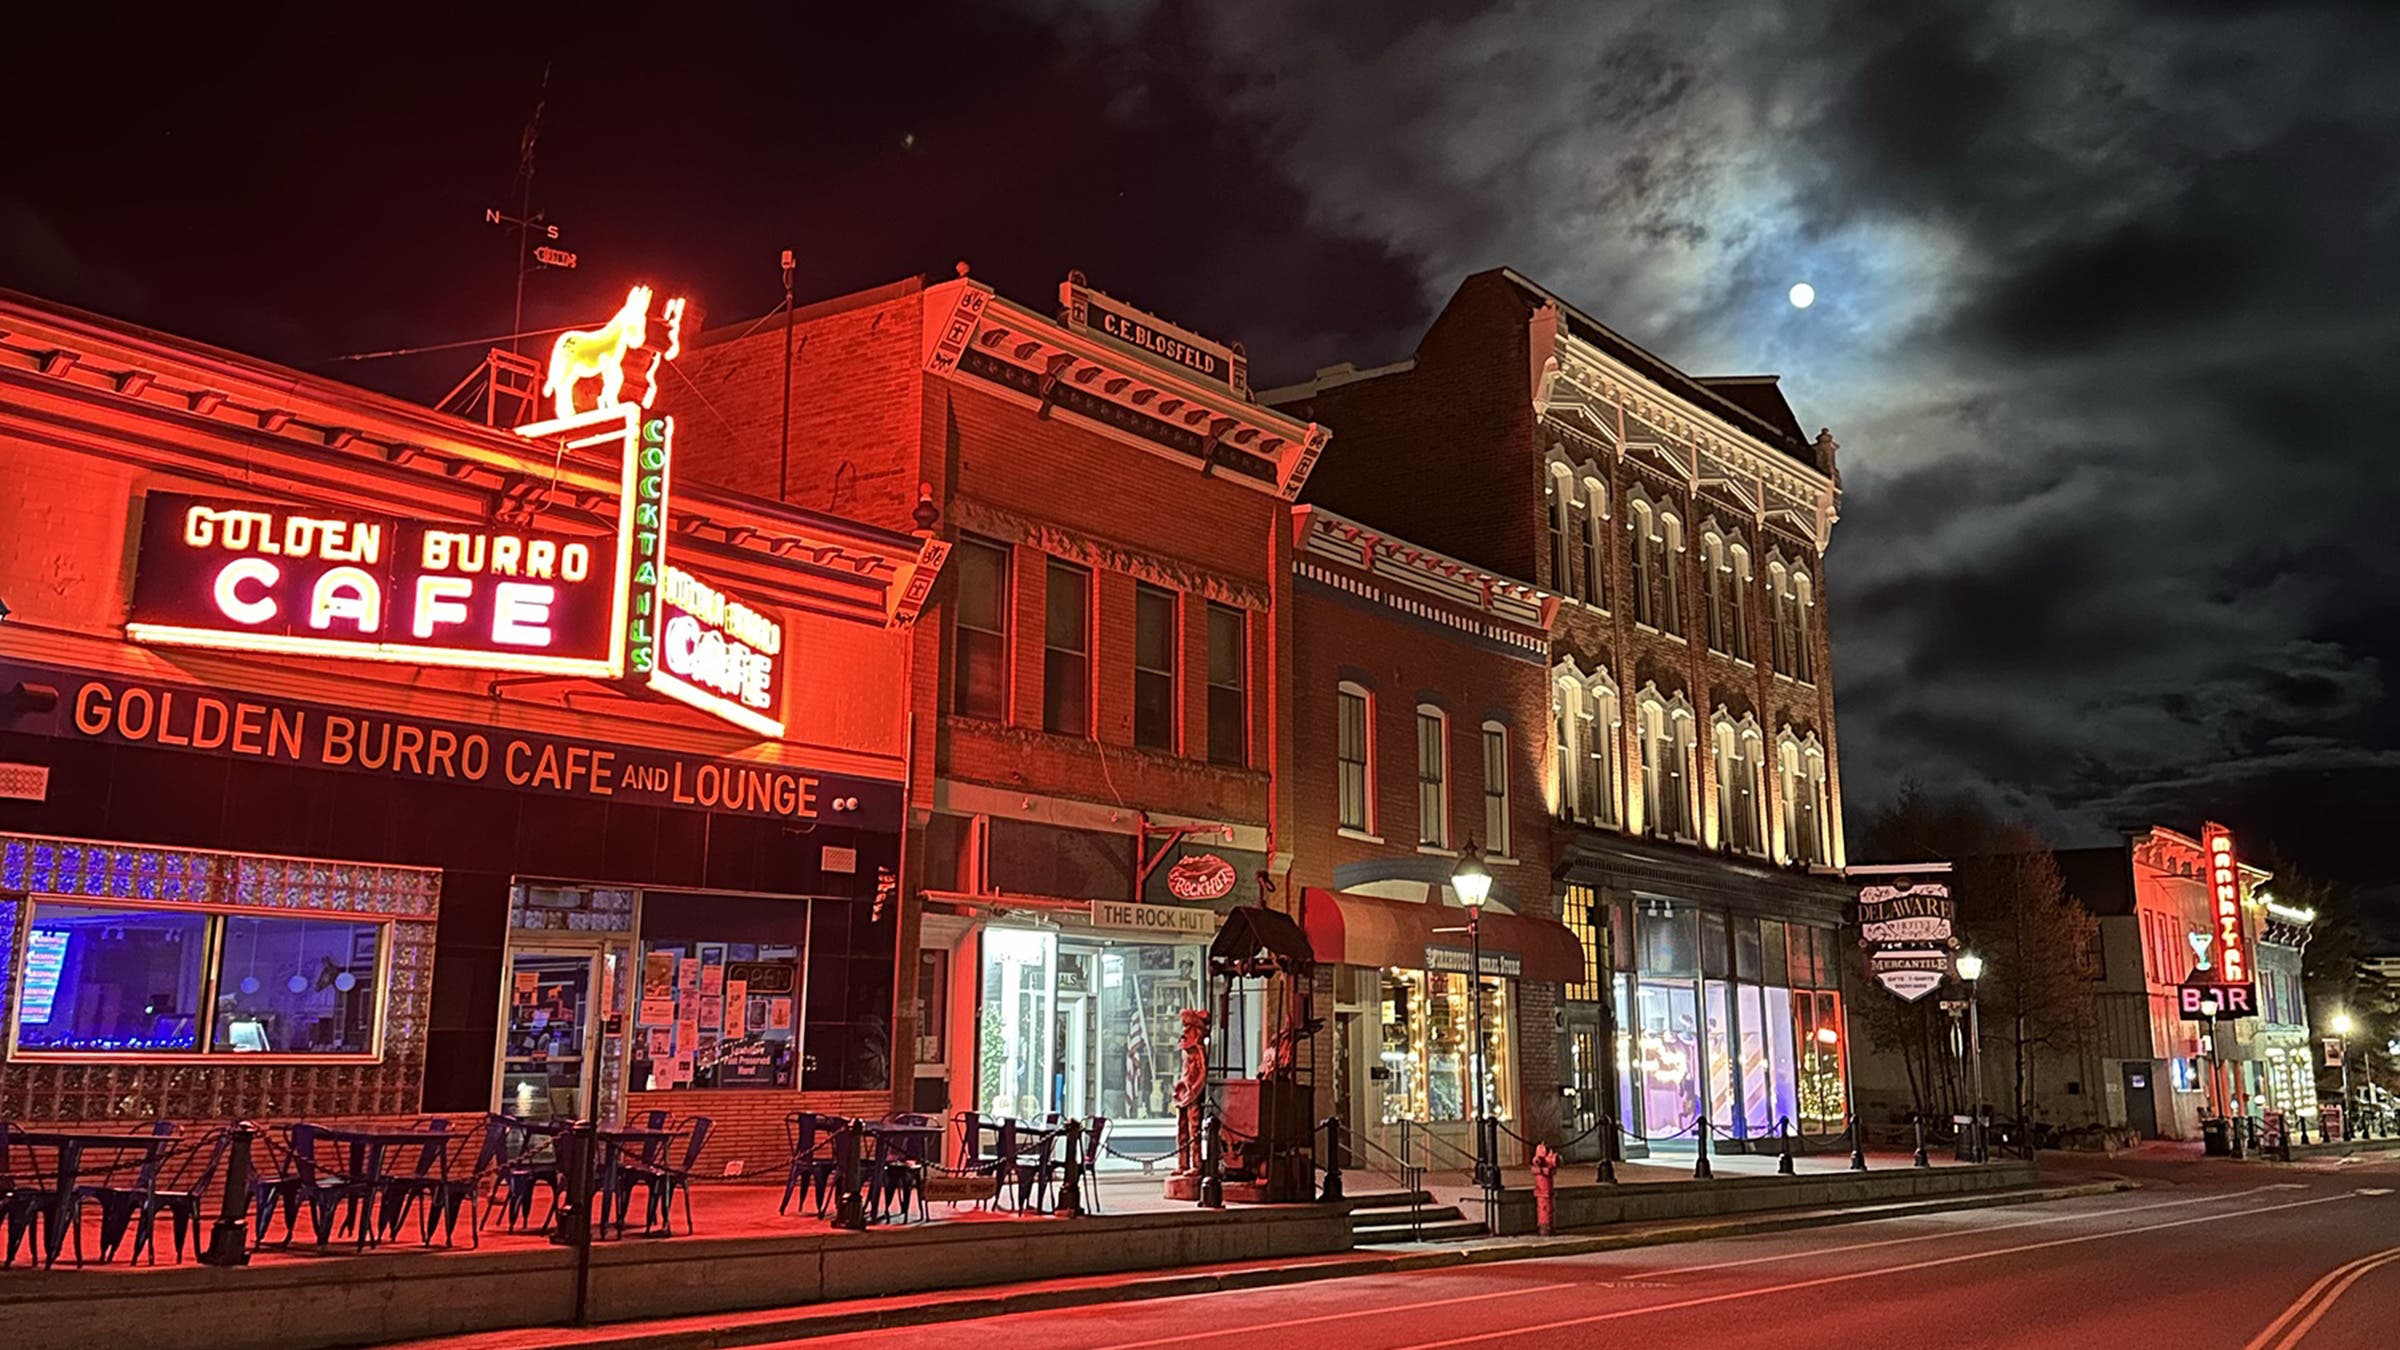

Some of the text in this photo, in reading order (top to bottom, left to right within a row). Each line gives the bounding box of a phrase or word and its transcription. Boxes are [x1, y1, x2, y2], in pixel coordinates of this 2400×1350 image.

[185, 505, 589, 583] GOLDEN BURRO
[631, 419, 665, 673] COCKTAILS
[214, 557, 556, 647] CAFE
[75, 682, 819, 818] GOLDEN BURRO CAFE AND LOUNGE
[1103, 905, 1207, 930] THE ROCK HUT
[1858, 897, 1951, 922] DELAWARE
[1872, 958, 1948, 971] MERCANTILE
